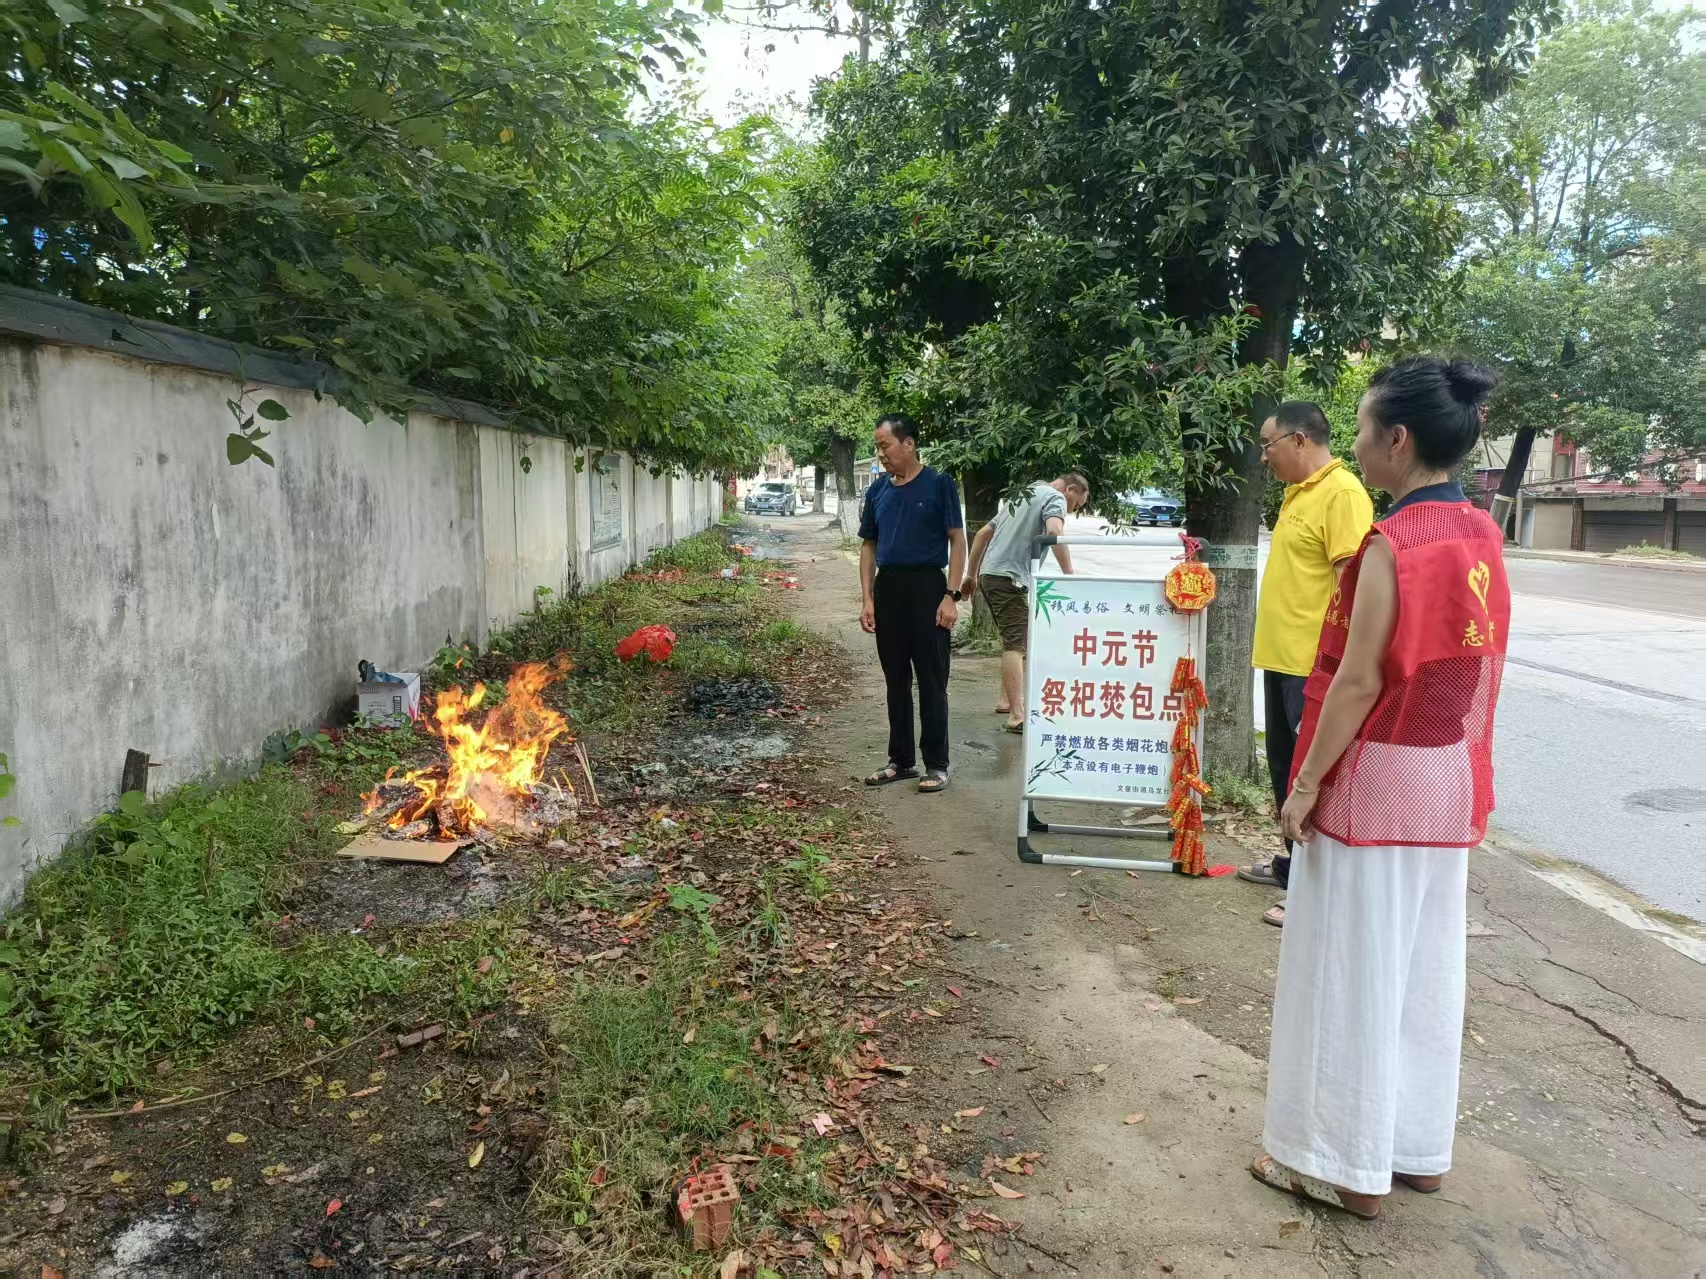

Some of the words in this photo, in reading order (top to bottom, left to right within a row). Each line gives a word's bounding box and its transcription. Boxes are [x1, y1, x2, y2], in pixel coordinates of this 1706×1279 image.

[1049, 600, 1110, 615] 移风易俗
[1073, 627, 1158, 669] 中元节
[1041, 677, 1184, 722] 祭祀焚包点
[1040, 733, 1169, 754] 严禁燃放各类烟花炮
